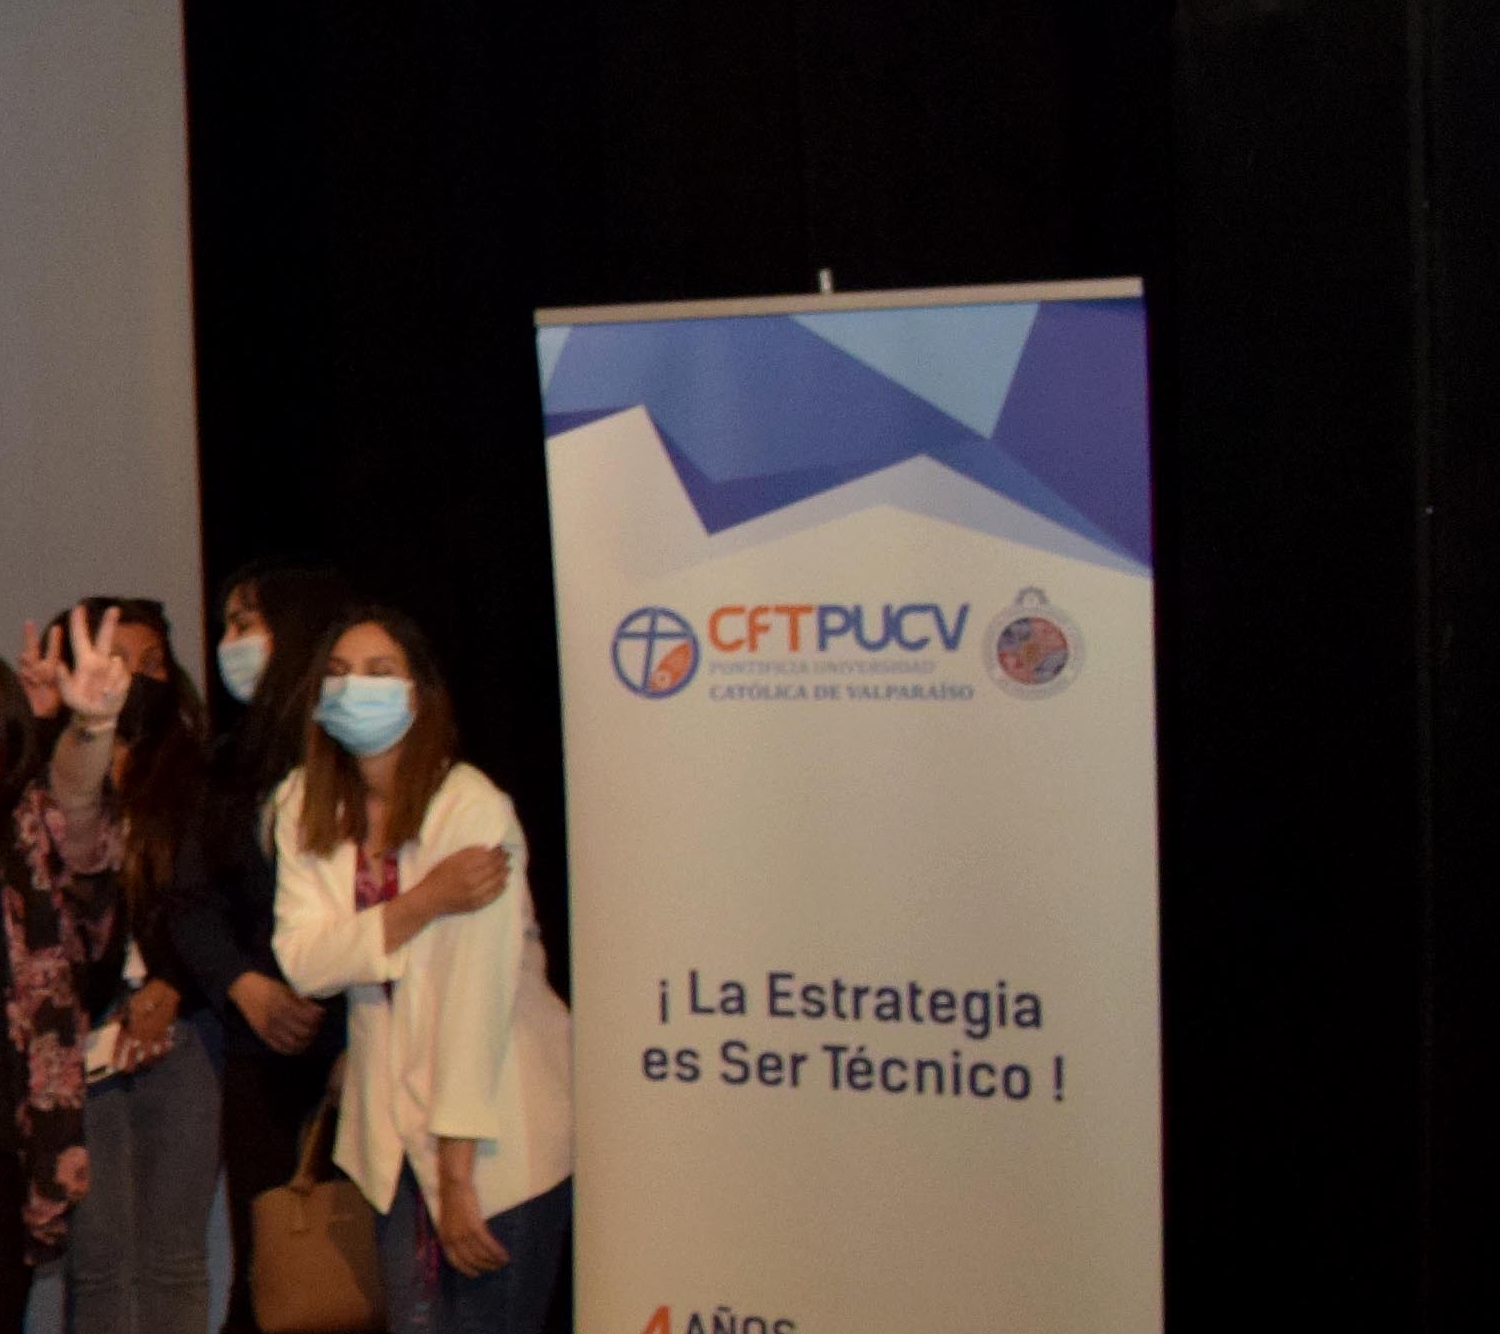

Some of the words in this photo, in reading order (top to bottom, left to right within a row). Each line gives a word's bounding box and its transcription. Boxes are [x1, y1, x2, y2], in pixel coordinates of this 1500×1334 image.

[813, 684, 842, 701] DE
[688, 969, 747, 1016] La
[767, 971, 1044, 1040] Estrategia
[642, 1045, 701, 1082] es
[719, 1040, 808, 1088] Ser
[821, 1043, 1032, 1102] Técnico
